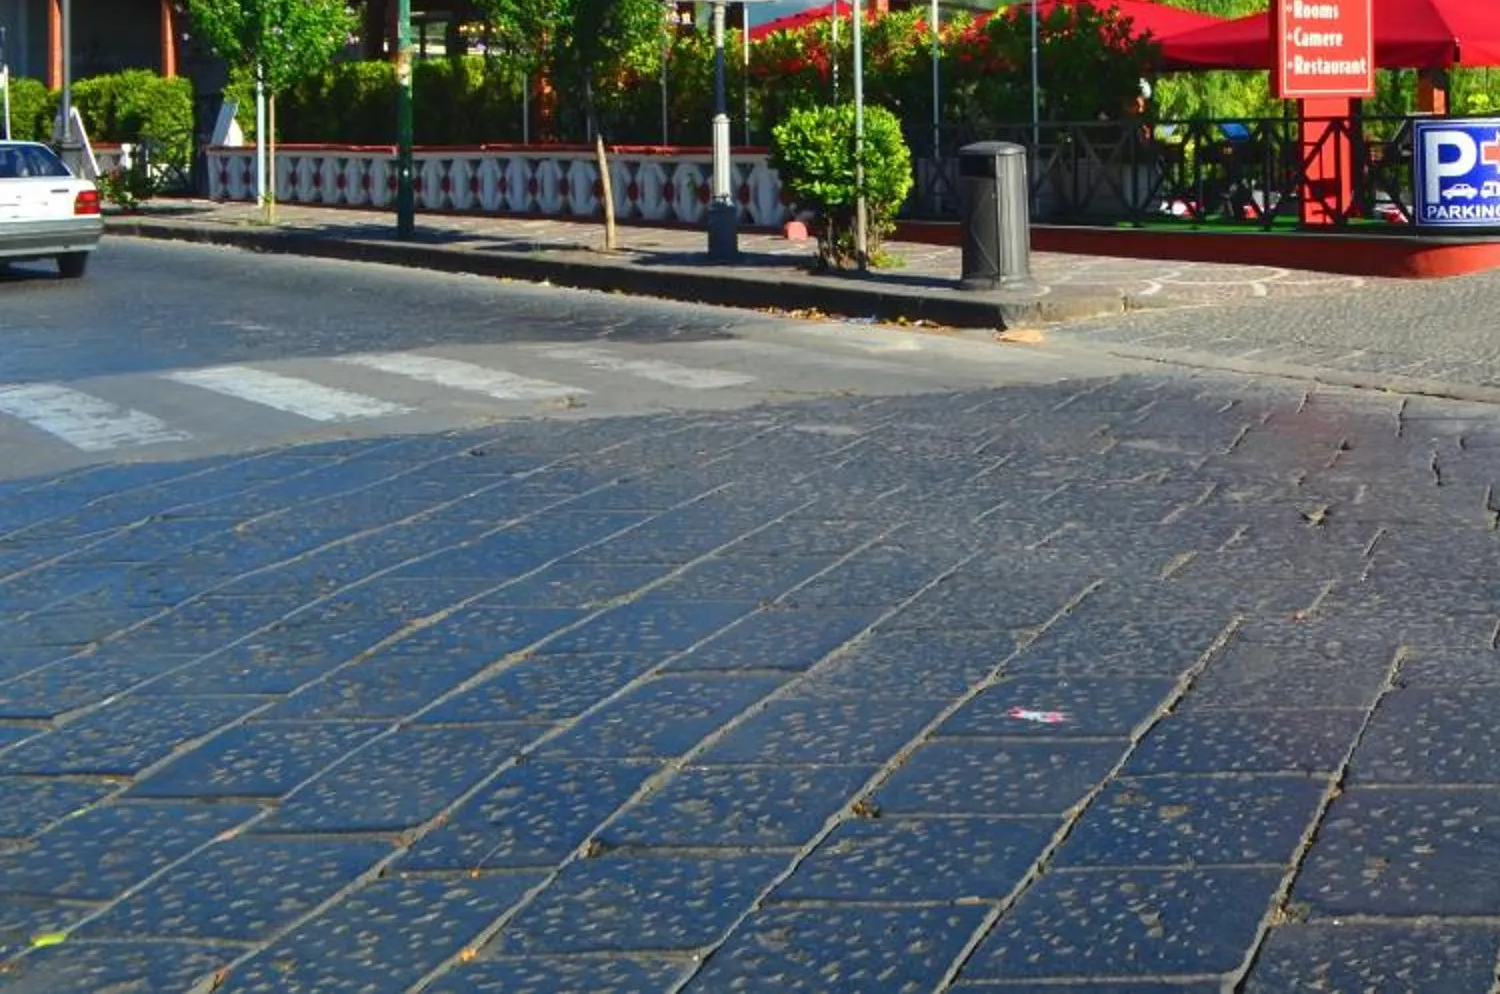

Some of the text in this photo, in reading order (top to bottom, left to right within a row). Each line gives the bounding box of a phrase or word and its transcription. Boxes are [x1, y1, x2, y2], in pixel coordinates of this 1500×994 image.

[1293, 26, 1344, 47] Camere
[1293, 55, 1367, 75] Restaurant
[1424, 130, 1477, 204] P
